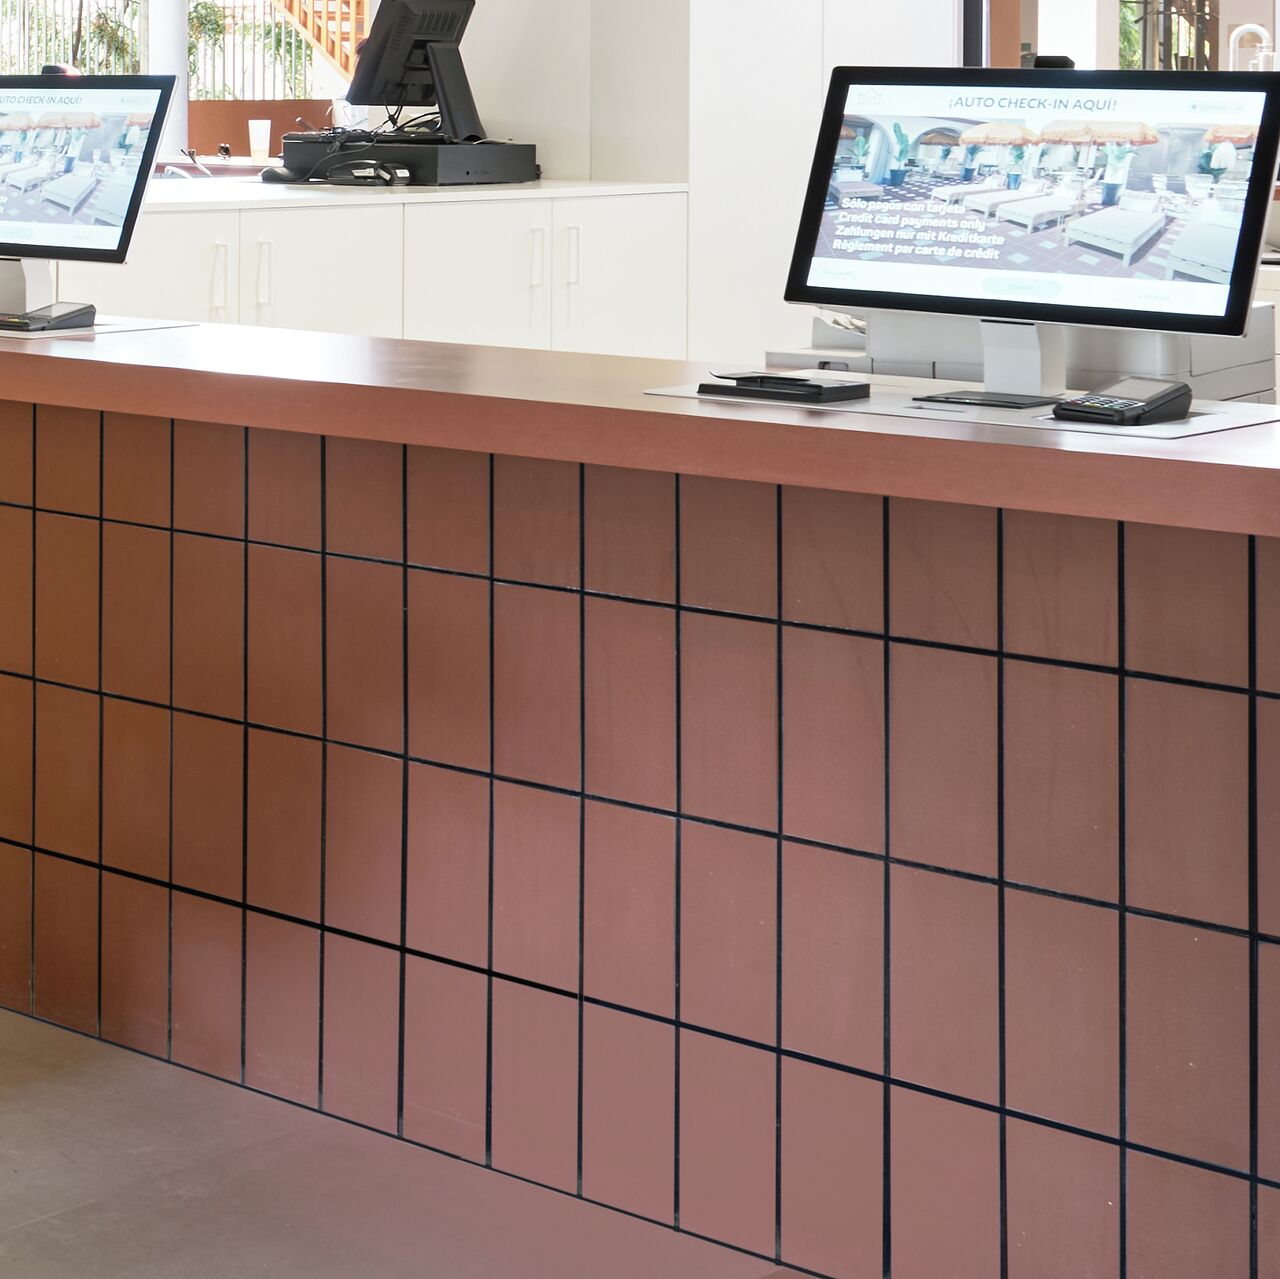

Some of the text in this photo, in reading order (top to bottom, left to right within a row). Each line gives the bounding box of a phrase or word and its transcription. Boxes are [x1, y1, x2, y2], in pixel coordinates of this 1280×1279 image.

[17, 95, 56, 105] CHECK-IN
[948, 96, 1117, 111] ¡AUTO CHECK-IN AQUÍ!
[867, 200, 902, 212] pagos
[903, 203, 925, 211] con
[926, 203, 966, 215] tarjeta
[839, 211, 986, 232] Credit card payments only
[834, 225, 1005, 245] Zahlungen nur mit Kreditkarte
[894, 244, 915, 256] par
[914, 246, 946, 256] carte
[947, 245, 963, 257] de
[964, 247, 1001, 260] crédit
